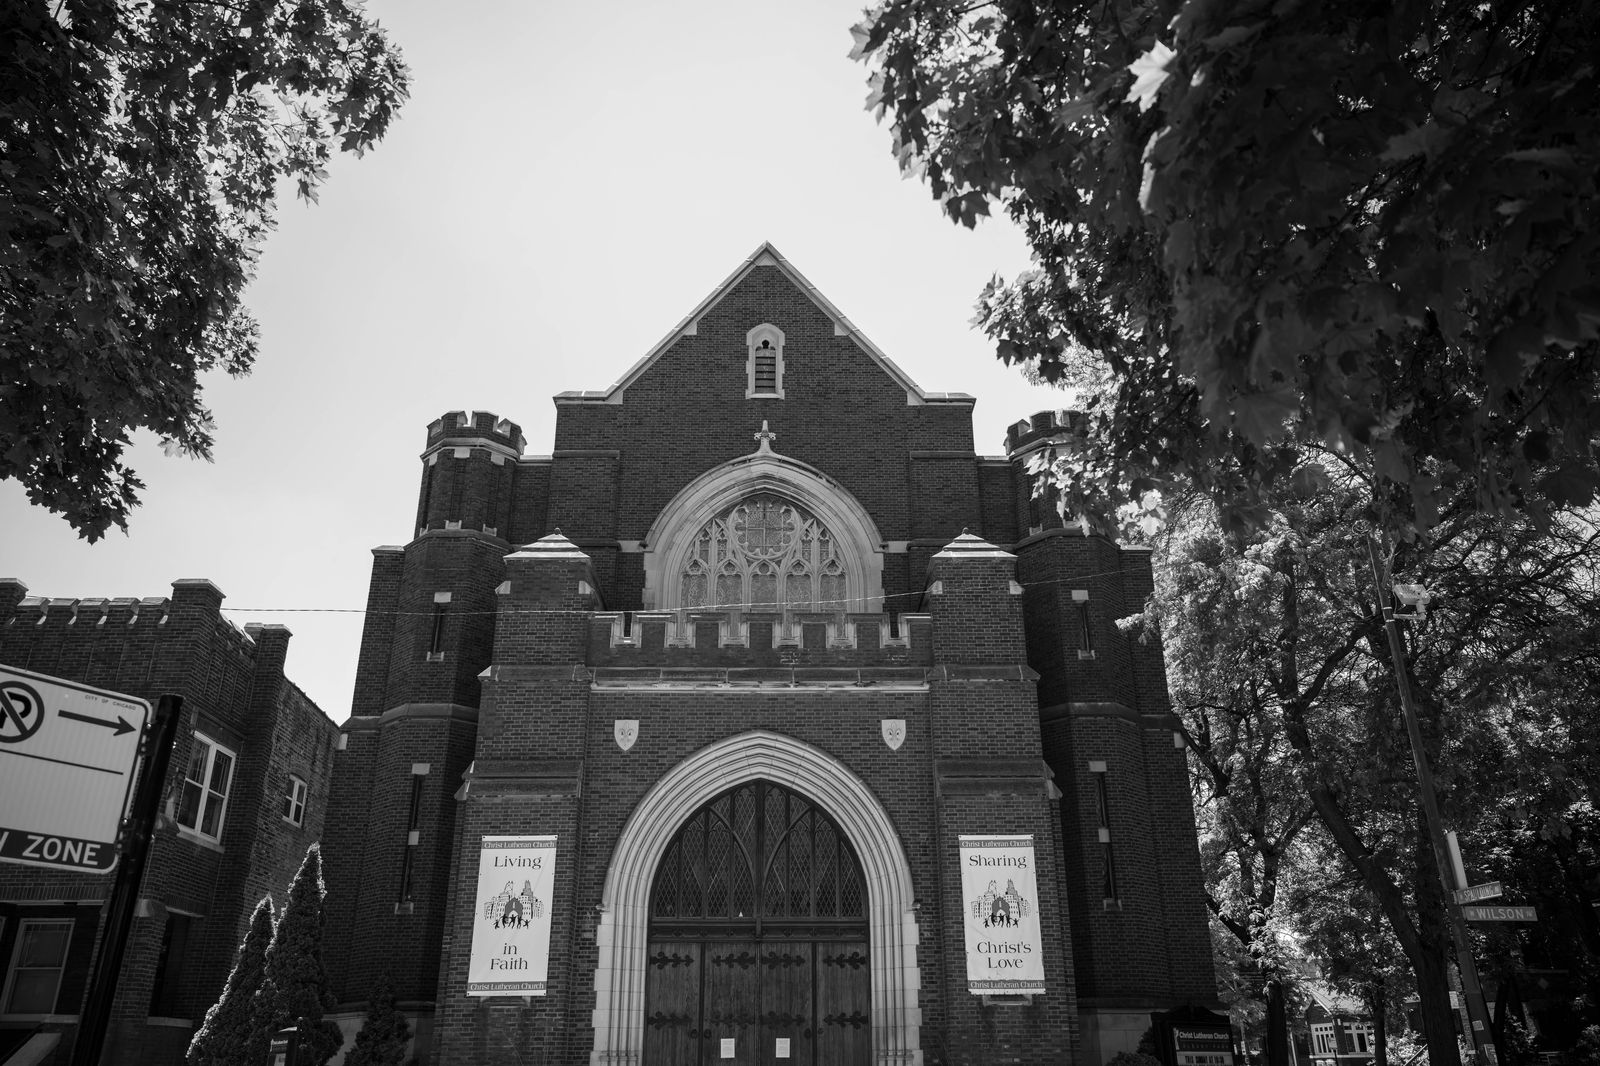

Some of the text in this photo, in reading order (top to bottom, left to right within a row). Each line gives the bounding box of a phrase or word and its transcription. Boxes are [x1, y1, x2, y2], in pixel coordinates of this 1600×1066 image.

[84, 694, 98, 702] CITY
[113, 701, 137, 711] CHICAGO
[22, 834, 101, 866] ZONE
[484, 841, 503, 849] Christ
[504, 841, 532, 849] Lutheran
[494, 856, 542, 870] Living
[969, 855, 1027, 869] Sharing
[1476, 908, 1524, 919] WILSON
[503, 943, 517, 955] in
[977, 941, 1032, 954] Christ's
[490, 958, 529, 970] Faith
[987, 957, 1024, 969] Love
[470, 982, 544, 991] Christ Lutheran Church
[970, 981, 990, 989] Christ
[991, 981, 1020, 989] Lutheran
[1214, 1032, 1229, 1040] Church
